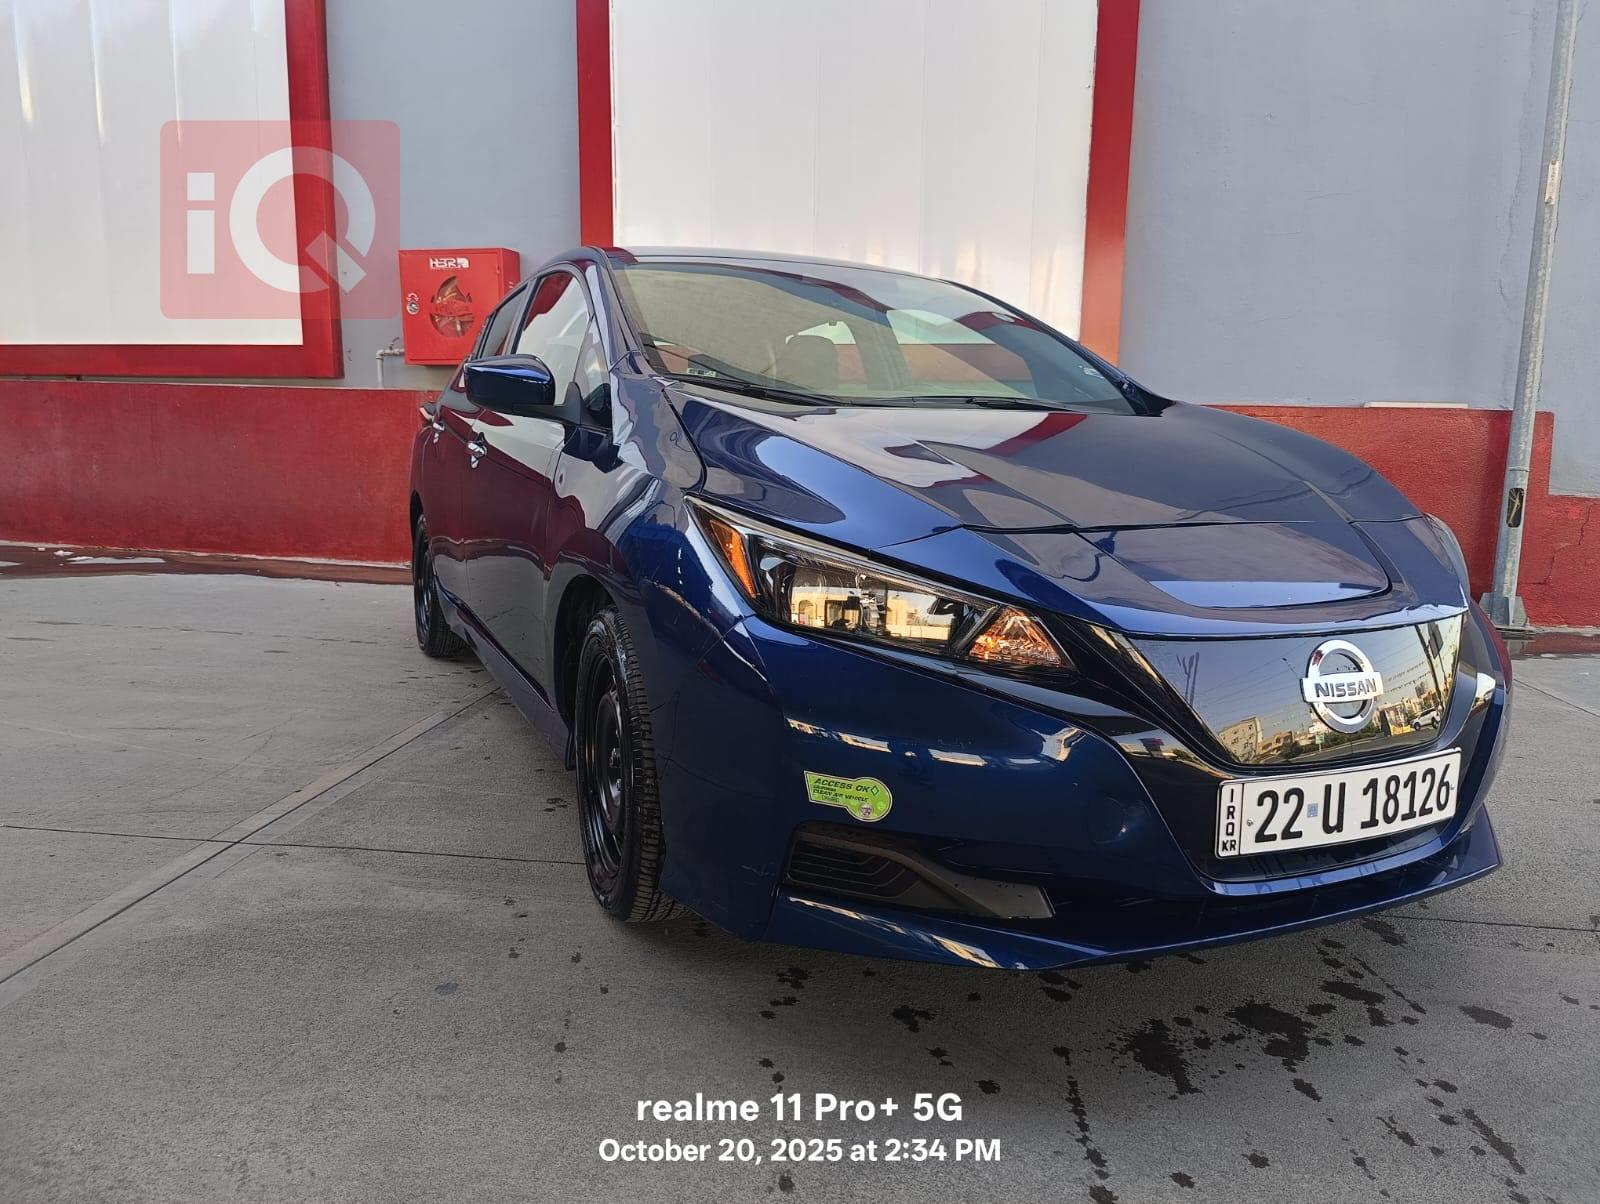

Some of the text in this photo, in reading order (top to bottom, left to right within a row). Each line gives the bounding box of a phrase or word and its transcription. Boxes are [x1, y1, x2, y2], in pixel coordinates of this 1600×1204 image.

[1314, 678, 1377, 698] NISSAN
[814, 778, 852, 789] ACCESS
[855, 784, 871, 793] OK
[1255, 764, 1450, 843] 22 U 18126
[1222, 839, 1236, 852] KR
